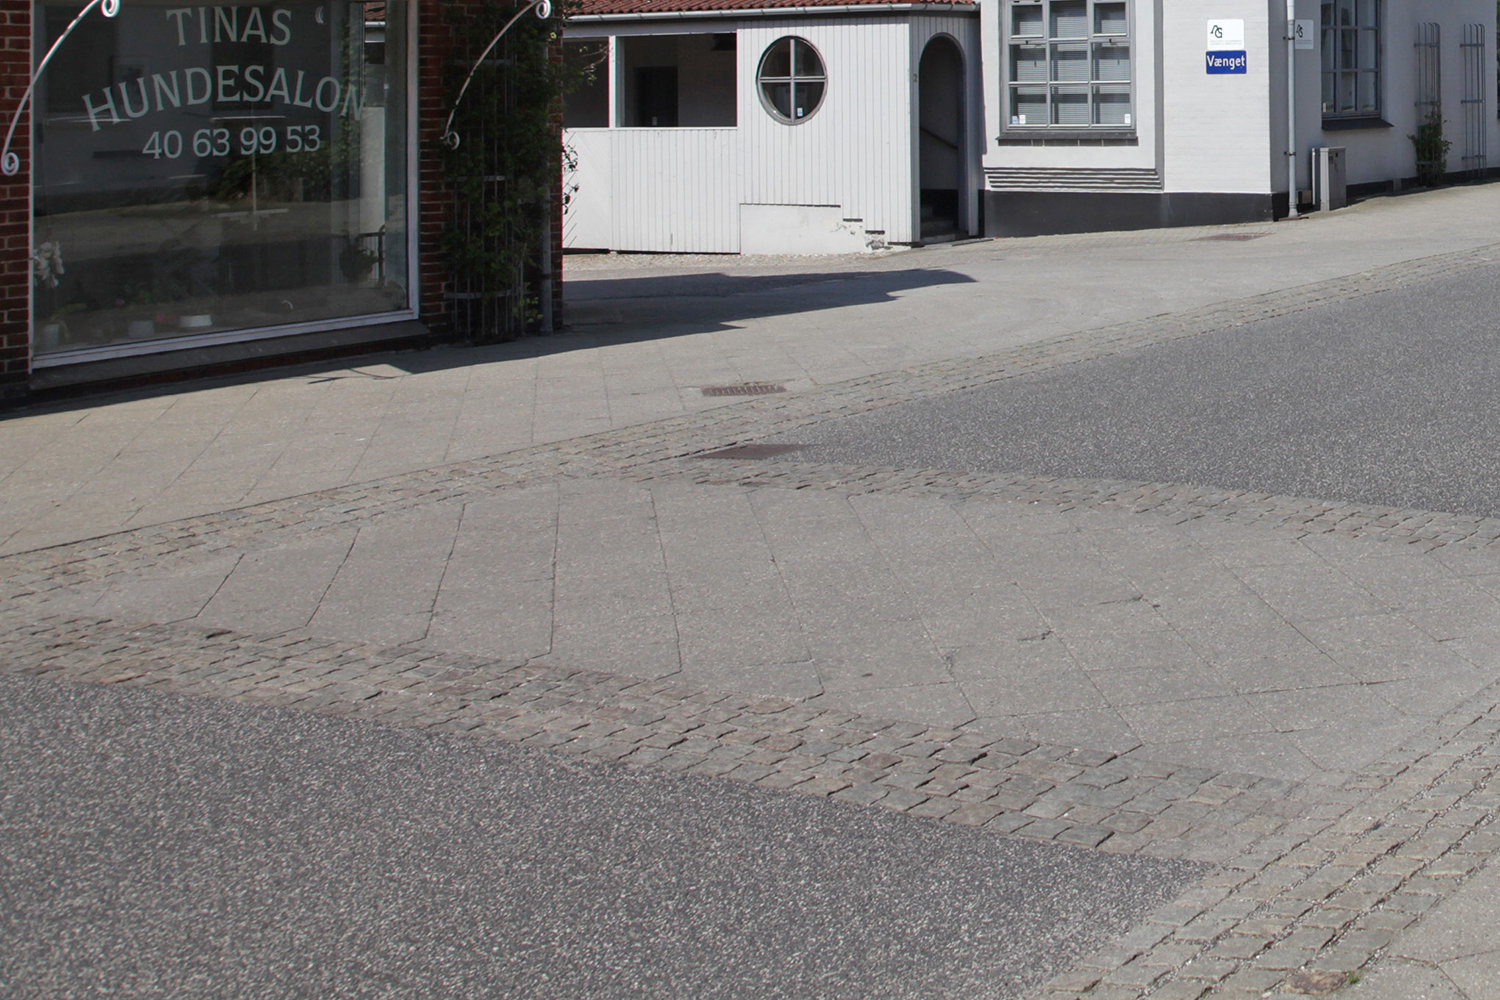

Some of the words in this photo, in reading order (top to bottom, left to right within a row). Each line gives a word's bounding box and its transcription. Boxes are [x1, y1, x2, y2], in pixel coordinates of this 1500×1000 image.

[166, 6, 292, 46] TINAS
[1206, 55, 1245, 70] Vænget
[81, 65, 367, 132] HUNDESALON
[142, 130, 183, 160] 40
[192, 128, 231, 157] 63
[239, 126, 278, 154] 99
[286, 124, 321, 152] 53
